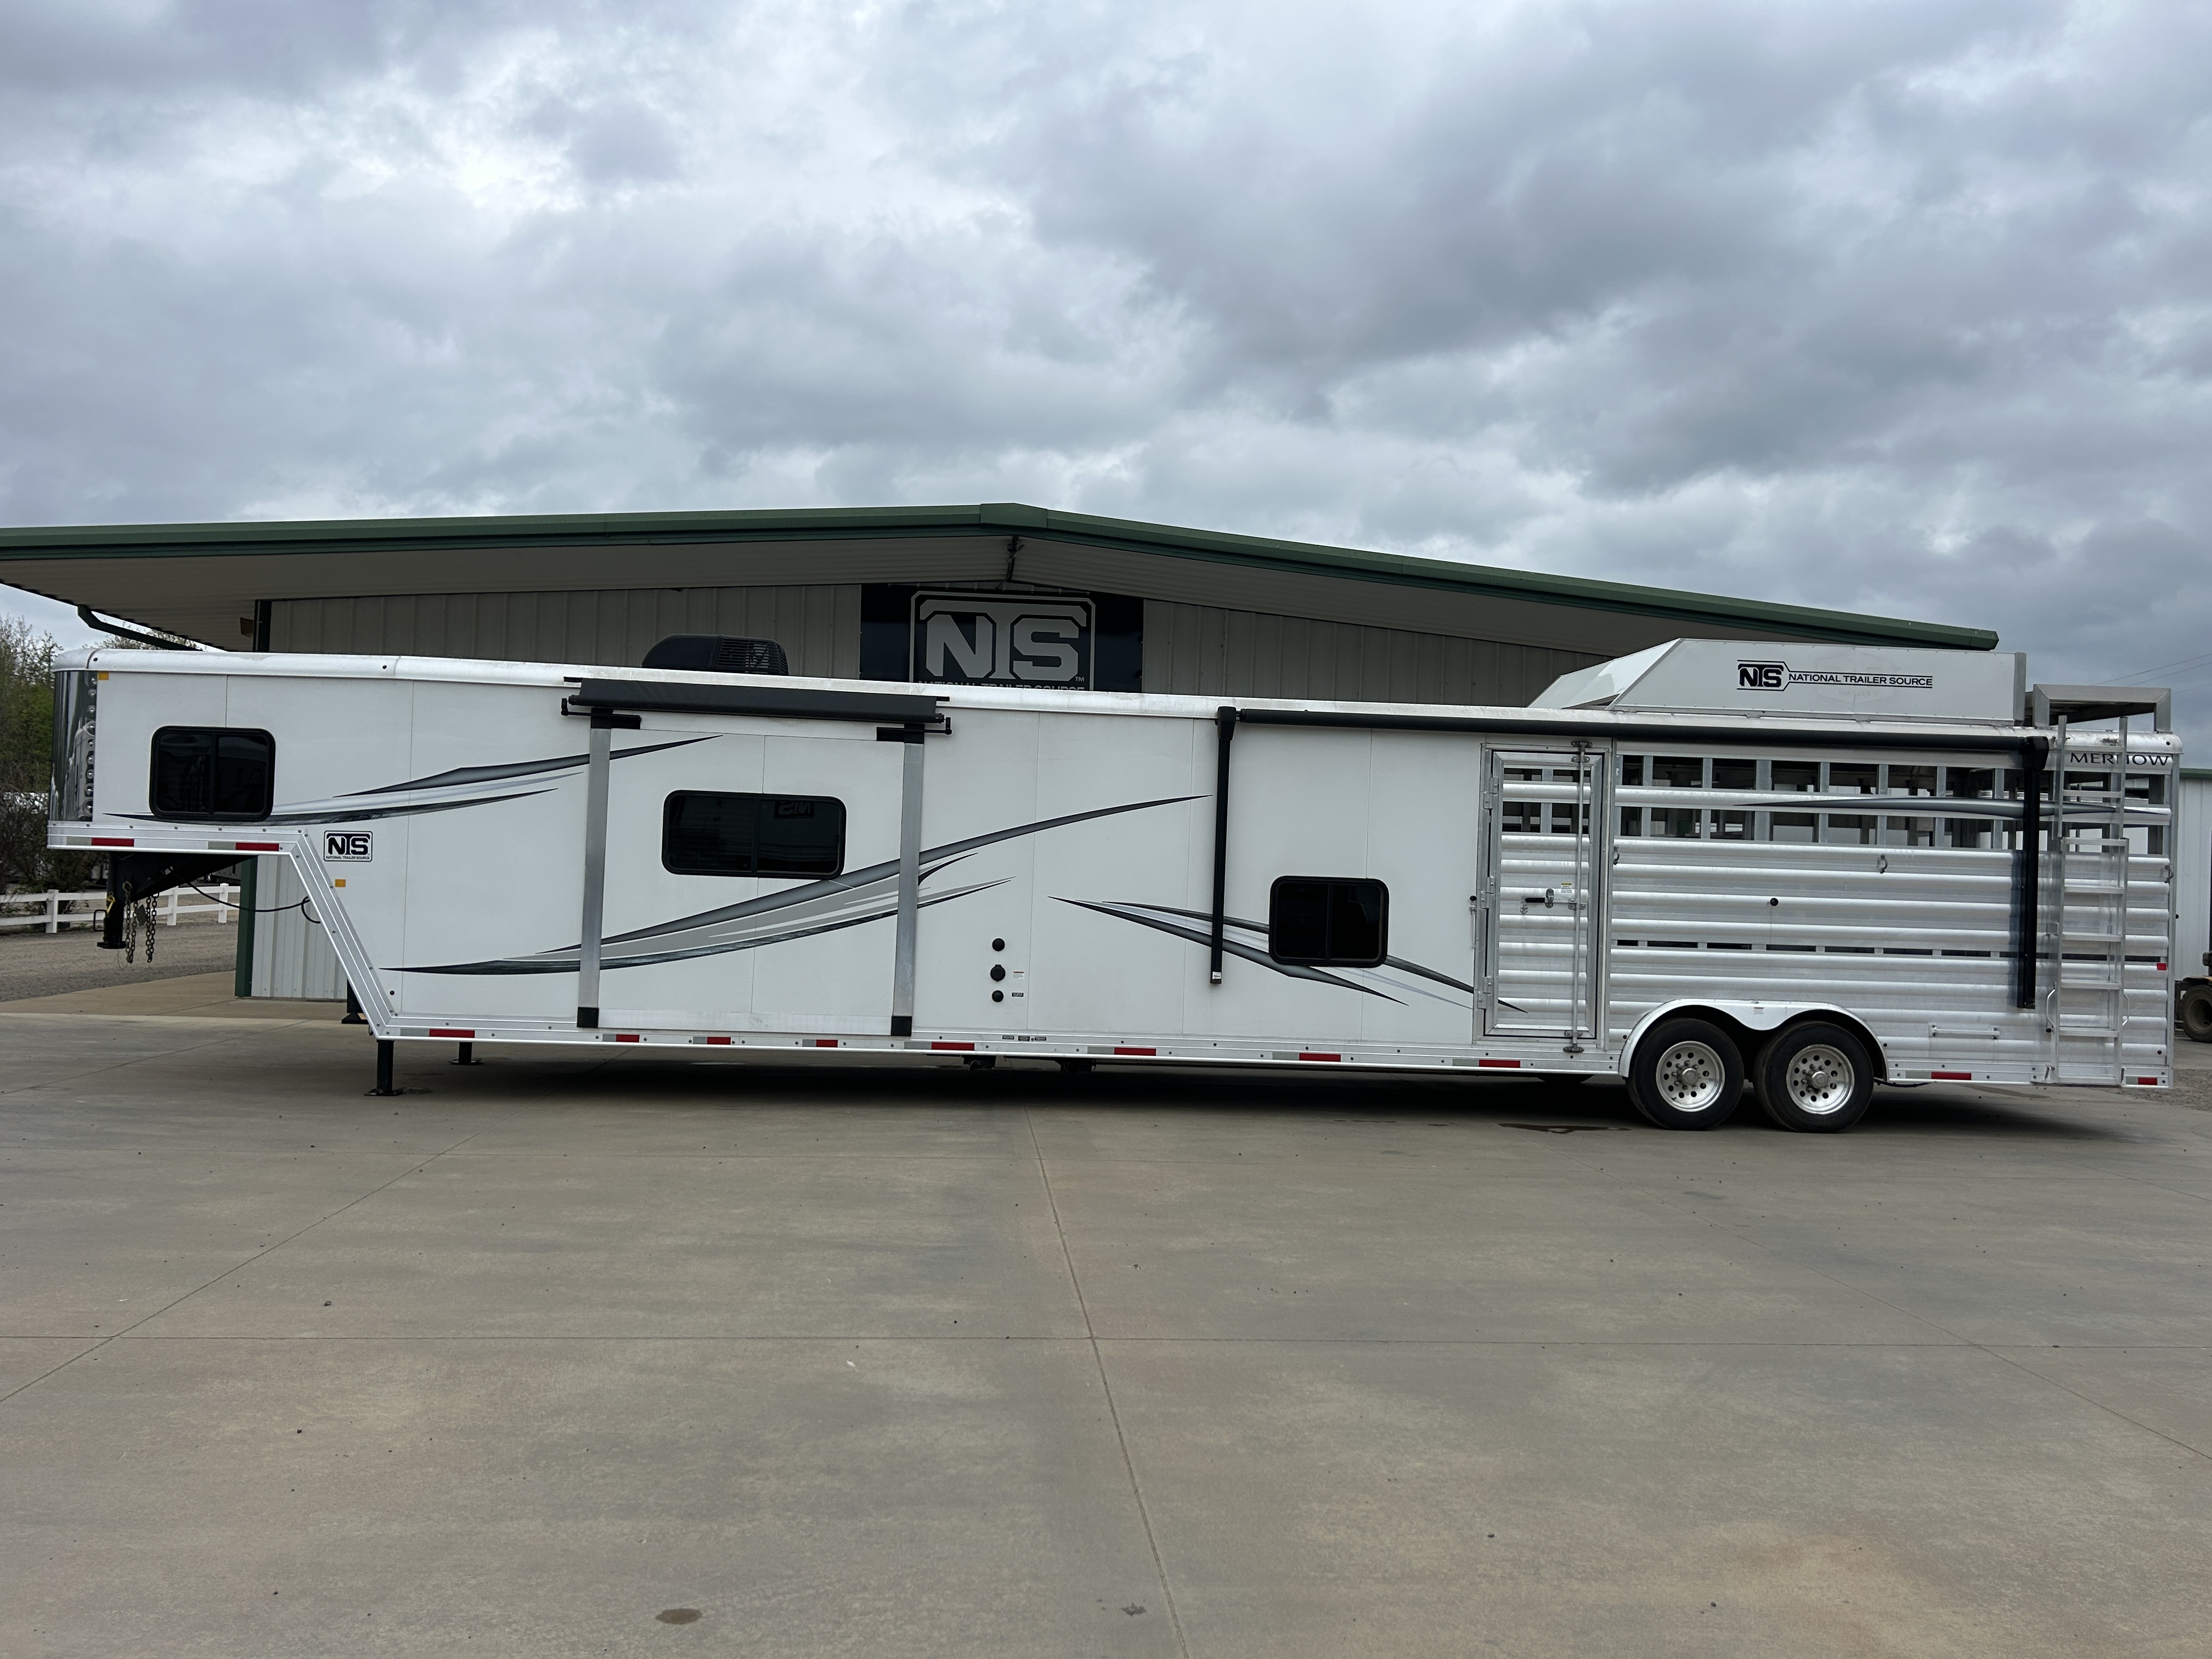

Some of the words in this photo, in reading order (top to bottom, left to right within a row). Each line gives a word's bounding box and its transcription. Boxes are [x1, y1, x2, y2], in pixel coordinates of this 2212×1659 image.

[920, 599, 1086, 681] NTS
[1738, 663, 1784, 687] NTS
[1788, 673, 1842, 682] NATIONAL
[1843, 675, 1887, 684] TRAILER
[1889, 676, 1933, 686] SOURCE
[326, 833, 370, 855] NTS
